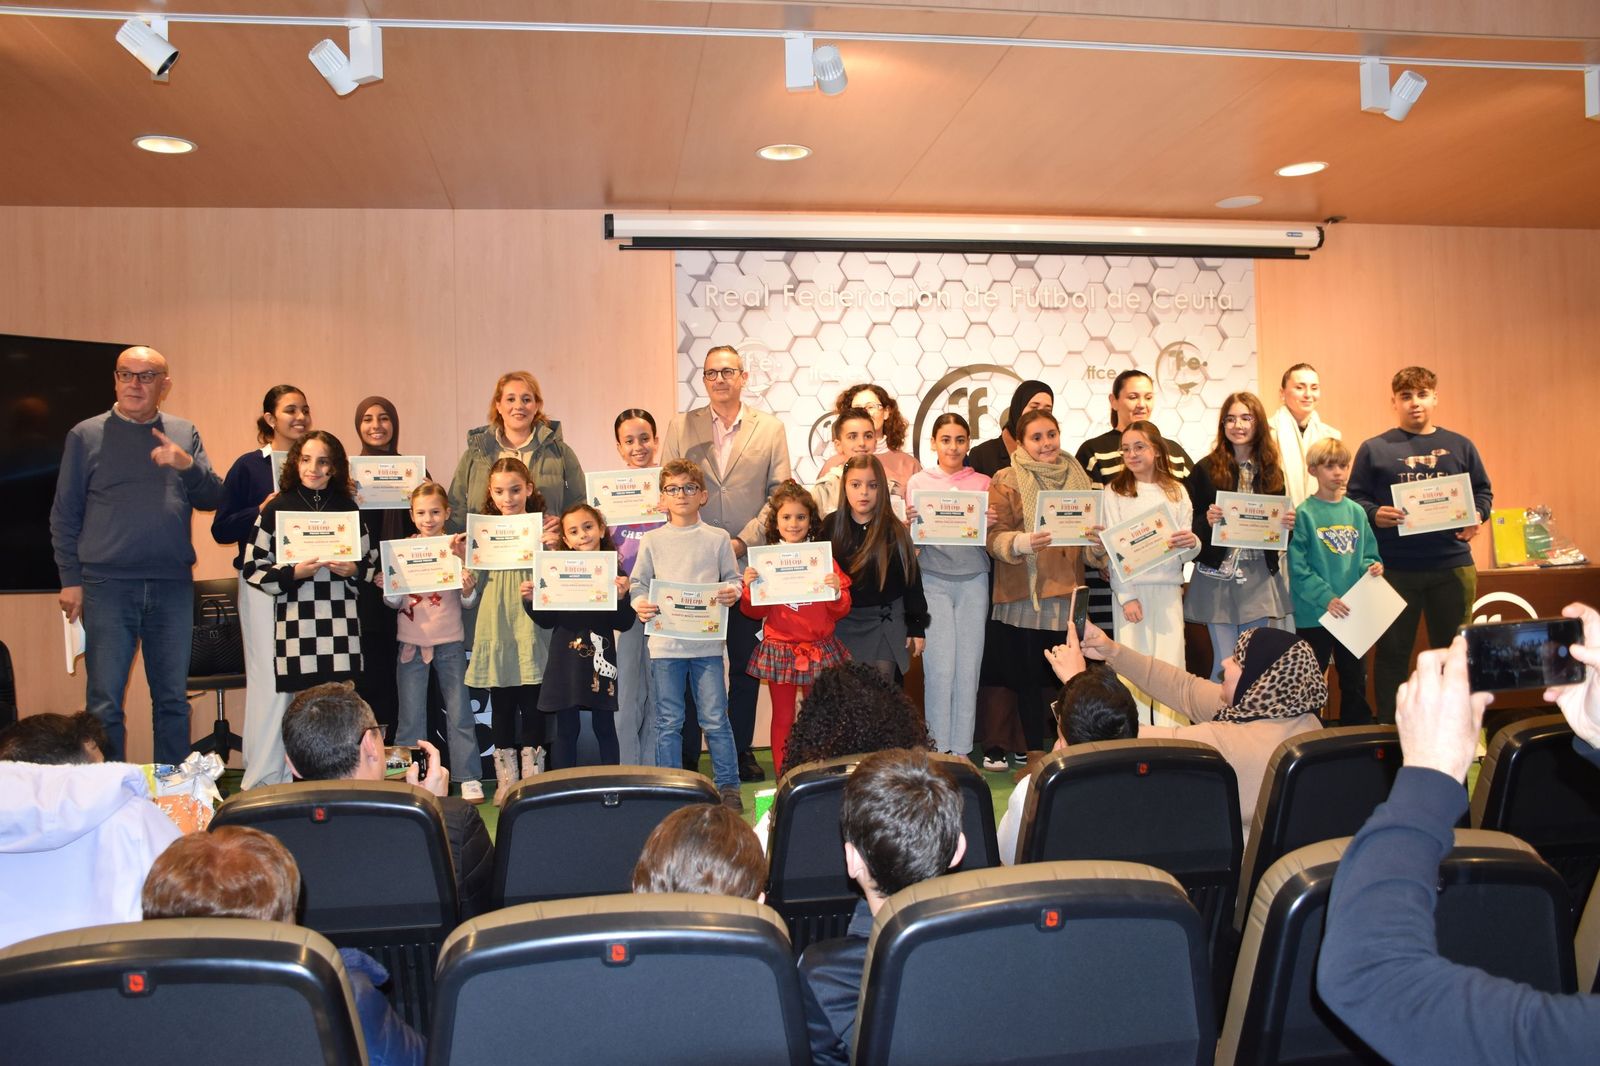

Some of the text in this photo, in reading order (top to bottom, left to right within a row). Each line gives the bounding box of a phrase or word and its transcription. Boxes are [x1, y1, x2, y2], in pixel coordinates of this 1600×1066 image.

[704, 279, 1233, 310] Real Federación de Fútbol de Ceuta
